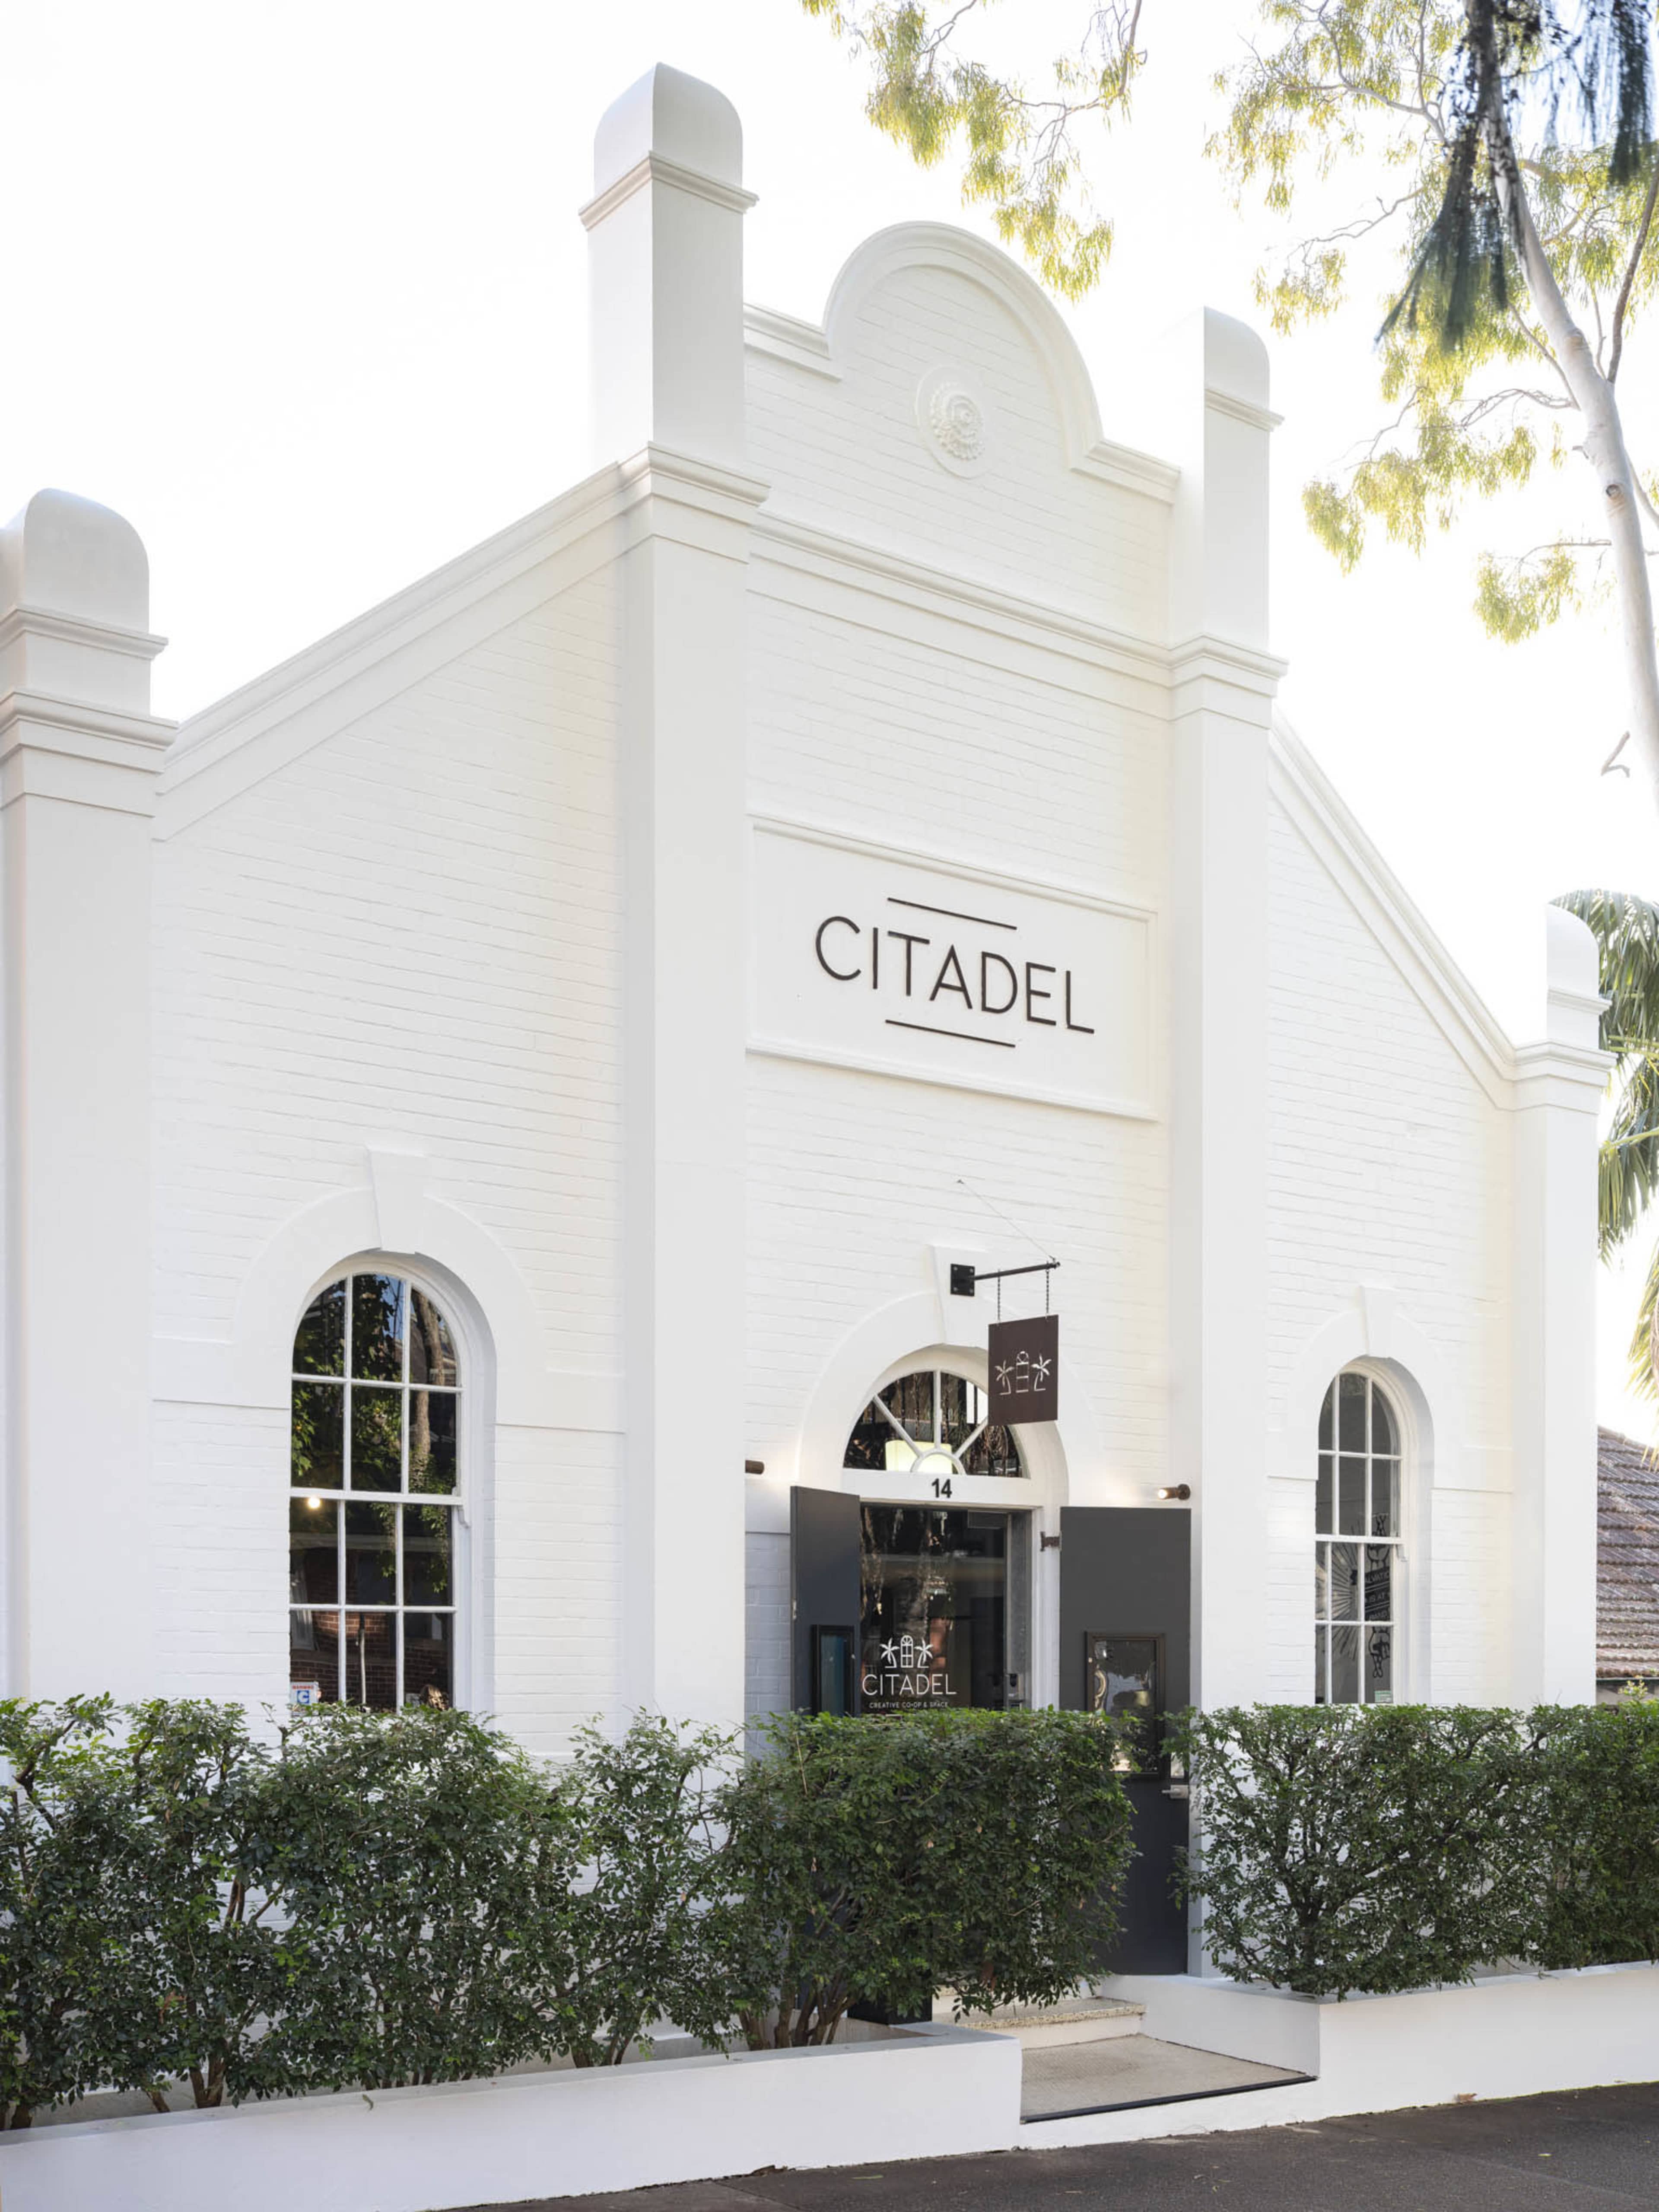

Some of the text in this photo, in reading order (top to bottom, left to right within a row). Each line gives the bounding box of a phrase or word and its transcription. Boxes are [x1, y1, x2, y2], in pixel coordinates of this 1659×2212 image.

[815, 915, 1095, 1034] CITADEL
[931, 1478, 952, 1498] 14
[862, 1674, 957, 1696] CITADEL
